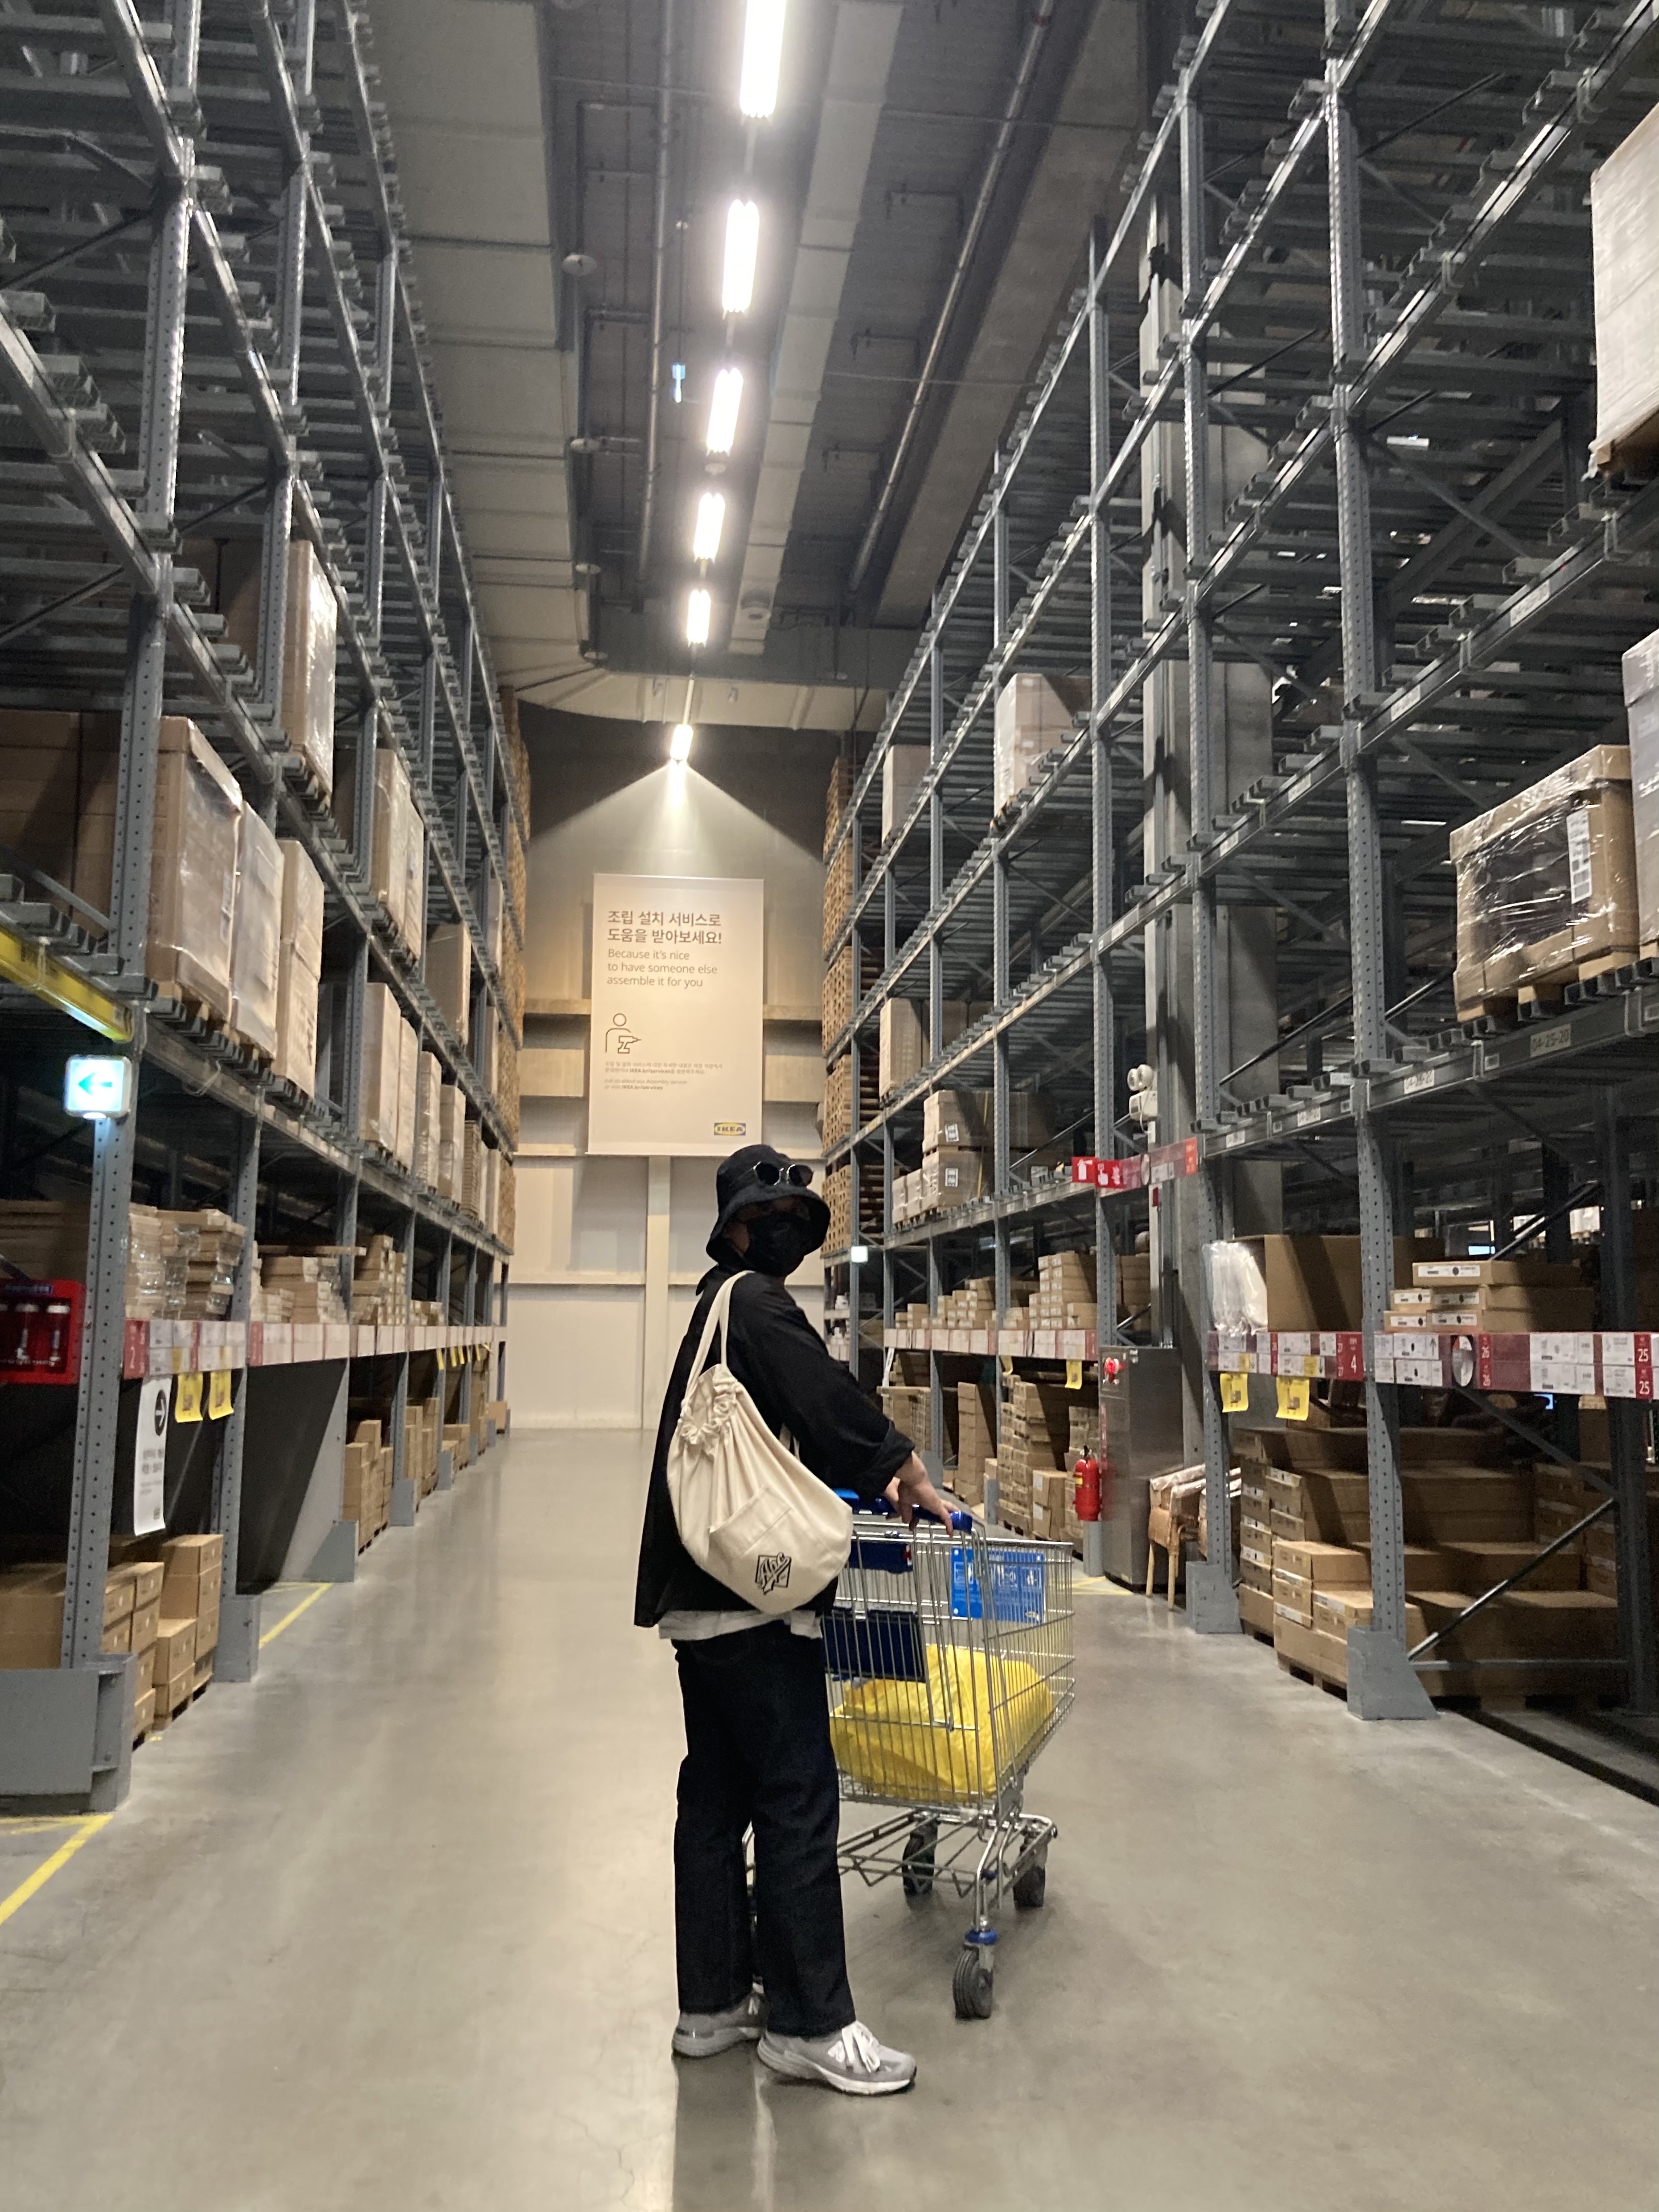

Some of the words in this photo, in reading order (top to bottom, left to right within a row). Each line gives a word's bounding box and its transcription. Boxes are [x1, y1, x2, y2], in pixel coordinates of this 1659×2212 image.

[607, 910, 633, 924] 조립
[638, 911, 664, 926] 설치
[669, 912, 722, 927] 서비스로
[607, 928, 648, 943] 도움을
[652, 930, 722, 944] 받아보세요!
[607, 948, 650, 959] Because
[653, 949, 667, 959] it's
[670, 950, 690, 960] nice
[607, 963, 618, 972] to
[621, 962, 645, 972] have
[648, 965, 695, 974] someone
[698, 964, 717, 974] else
[607, 976, 655, 986] assemble
[658, 977, 665, 986] it
[667, 977, 681, 986] for
[684, 978, 703, 989] you
[1637, 1348, 1649, 1362] 25
[1350, 1354, 1357, 1374] 4
[1639, 1380, 1650, 1395] 25
